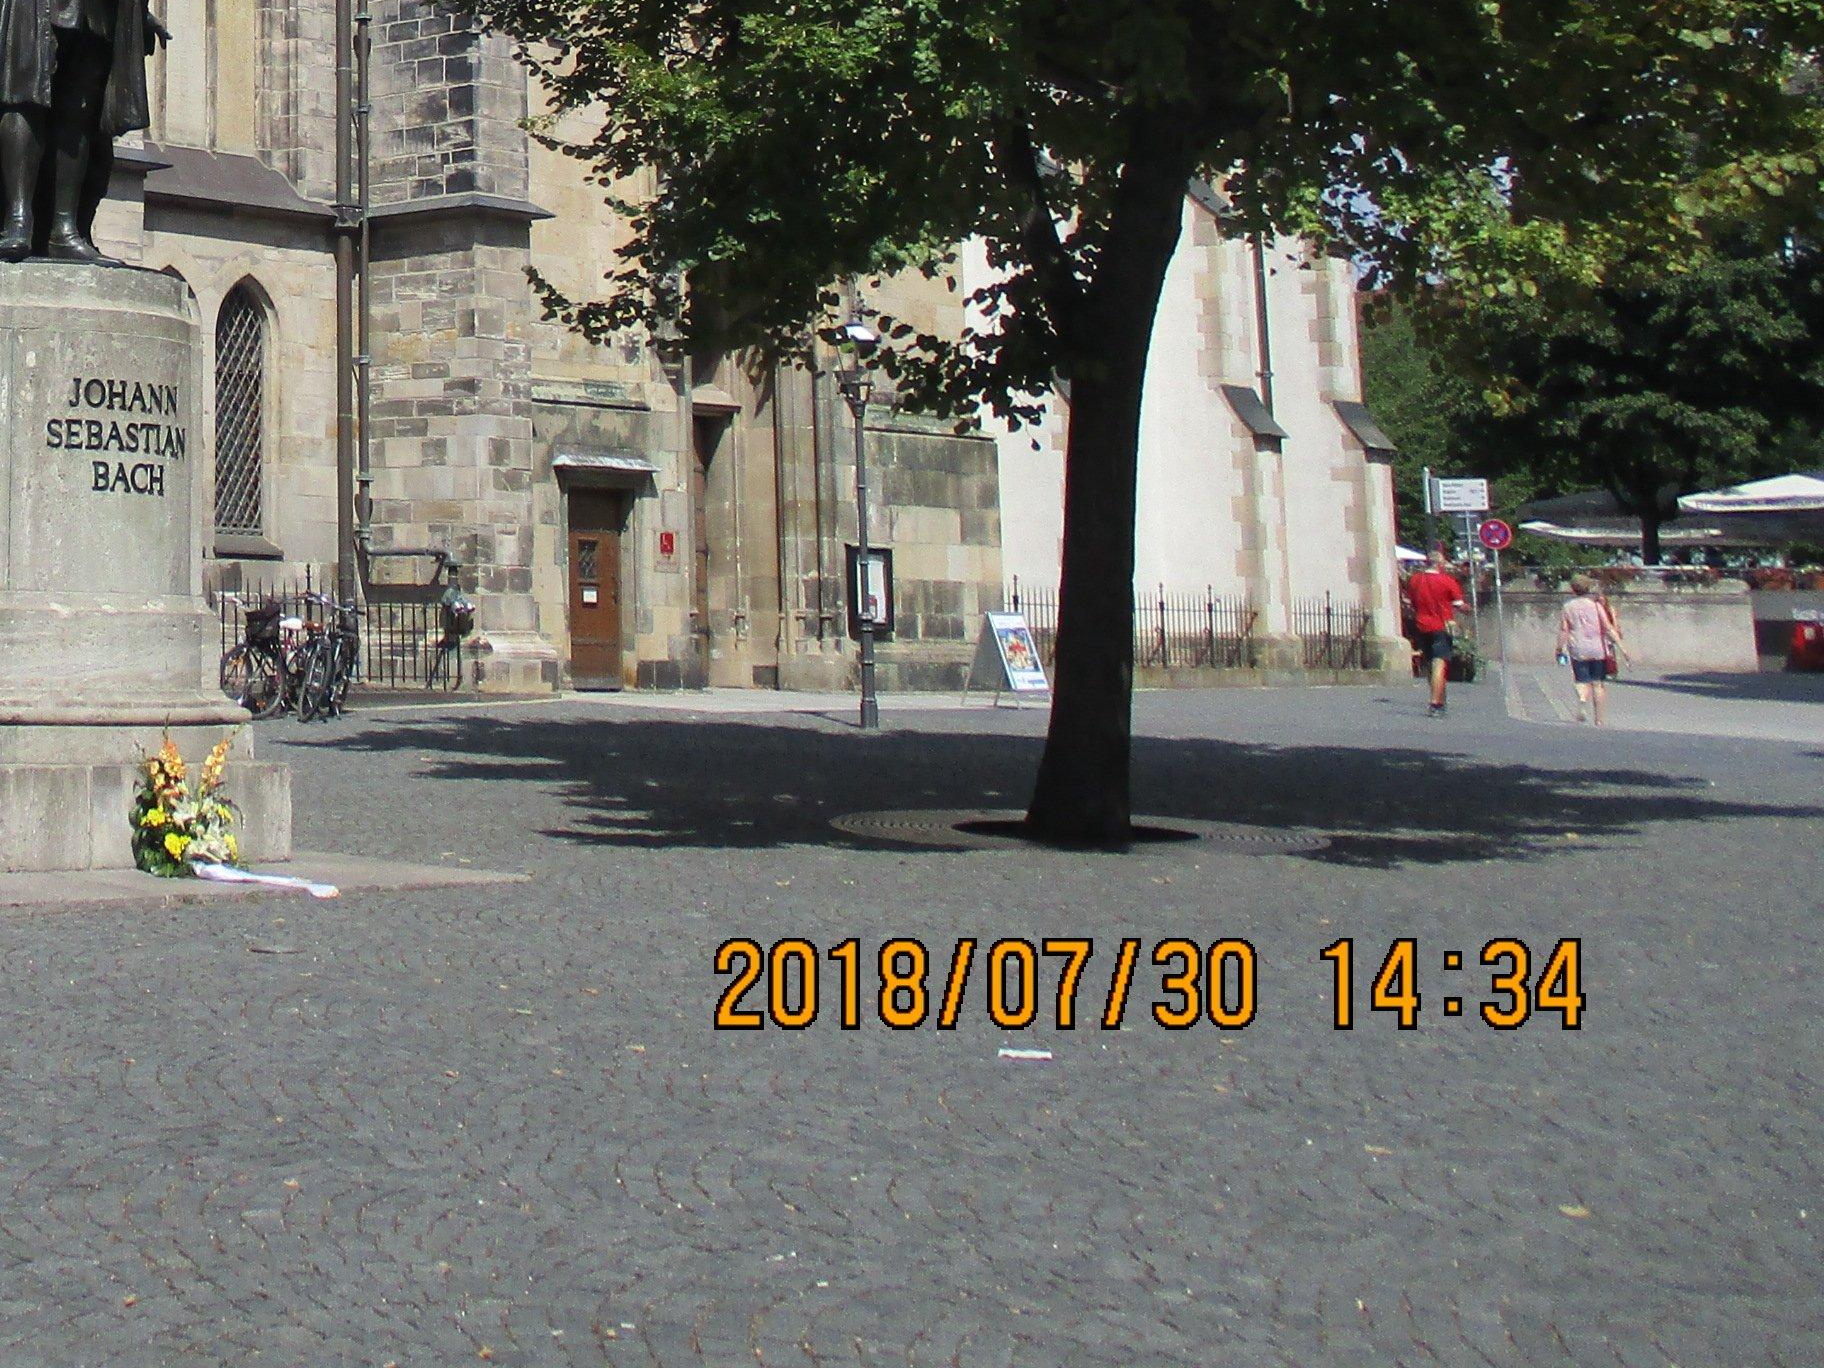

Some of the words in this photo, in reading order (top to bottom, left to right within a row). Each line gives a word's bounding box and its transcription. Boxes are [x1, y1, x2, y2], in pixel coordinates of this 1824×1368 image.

[69, 378, 178, 417] JOHANN
[46, 418, 186, 462] SEBASTIAN
[92, 461, 164, 496] BACH
